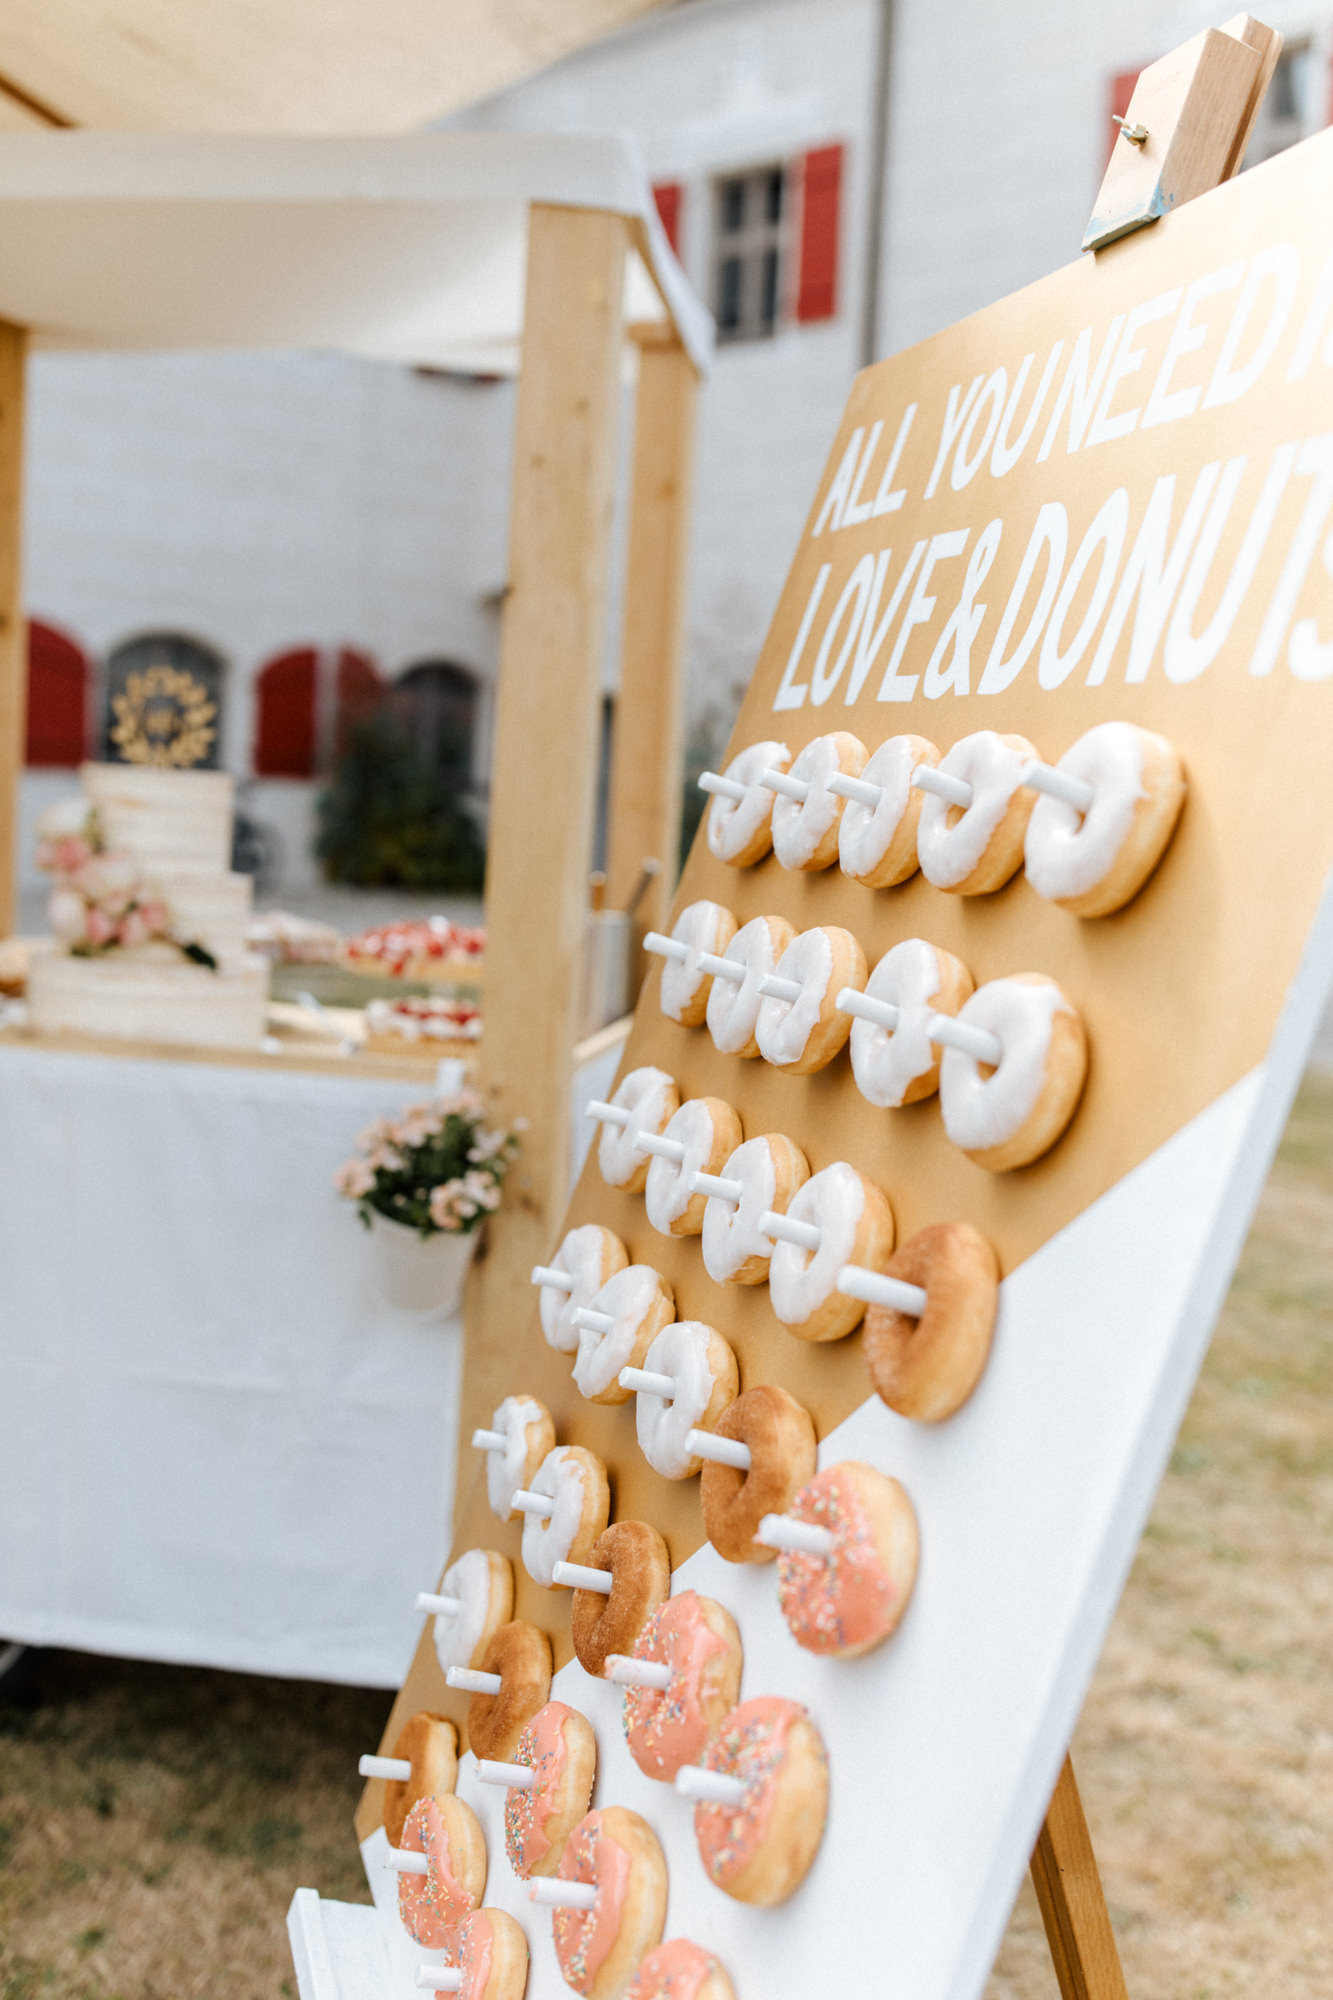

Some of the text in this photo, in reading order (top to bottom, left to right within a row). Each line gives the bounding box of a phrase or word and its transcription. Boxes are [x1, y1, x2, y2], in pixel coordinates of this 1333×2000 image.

[811, 243, 1333, 537] ALL YOU NEED I
[771, 527, 970, 712] LOVE
